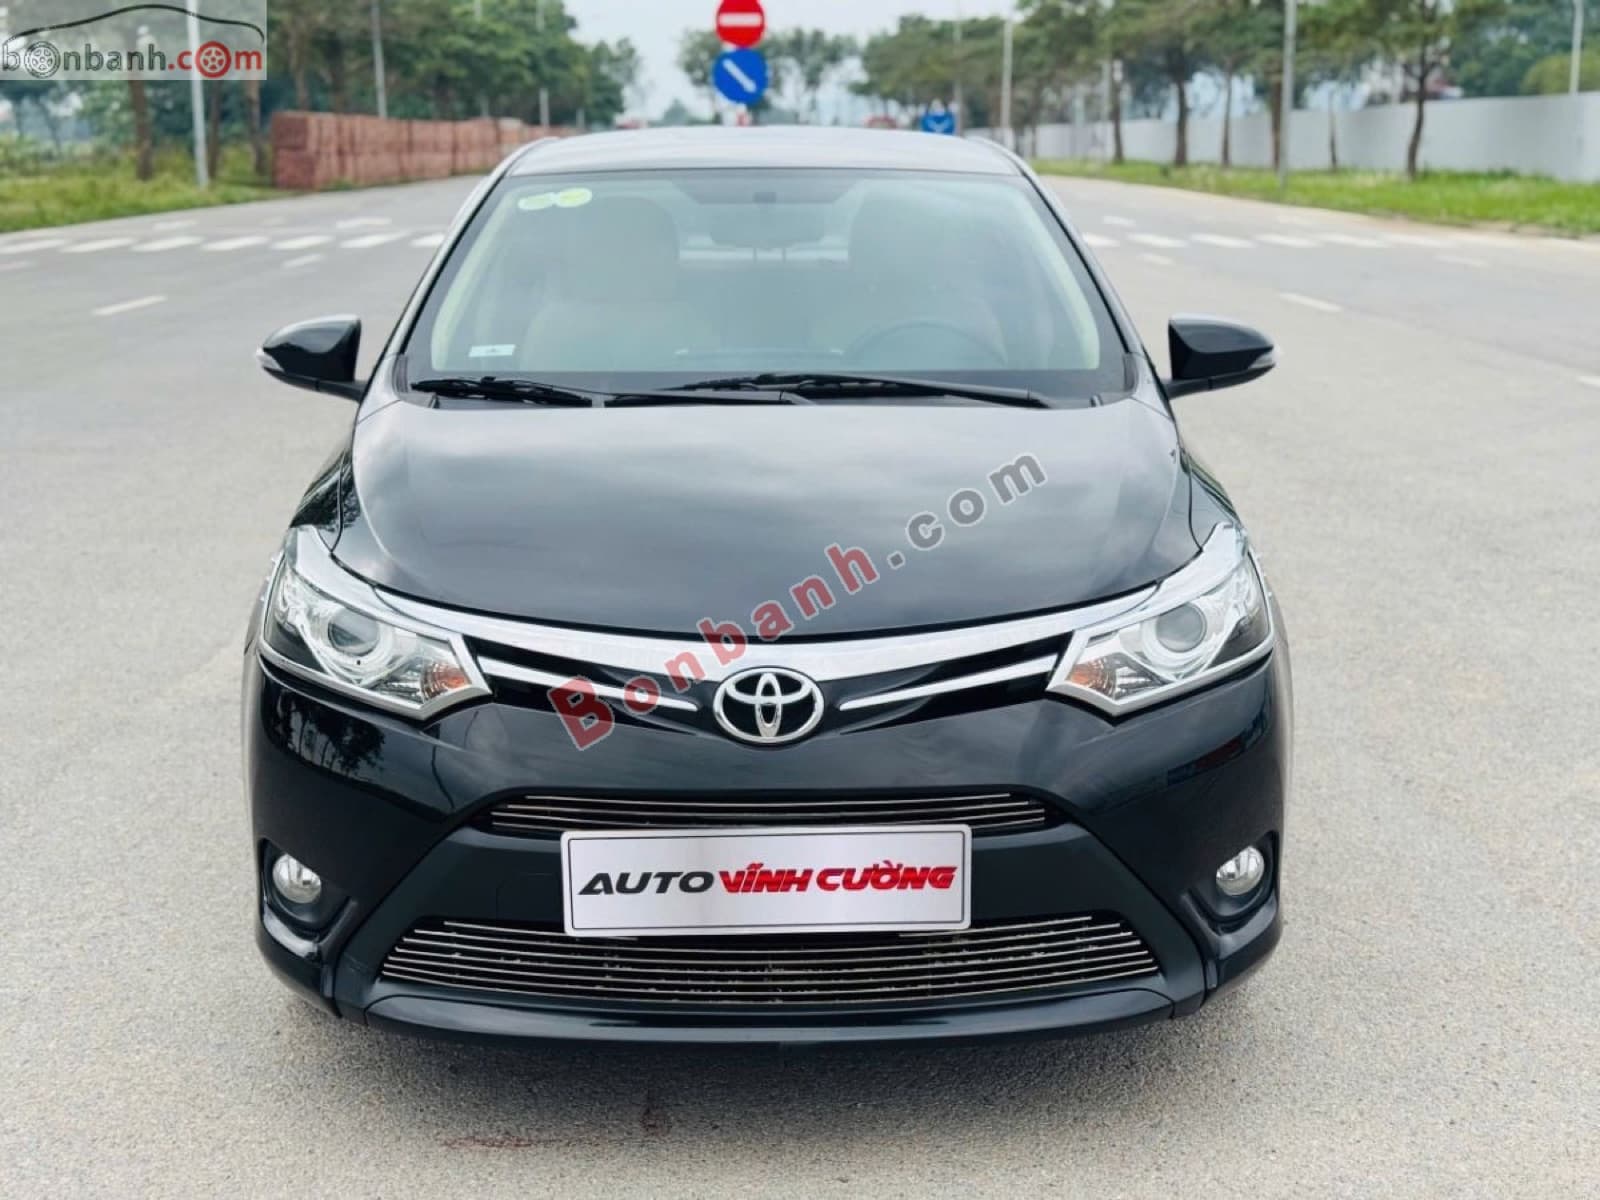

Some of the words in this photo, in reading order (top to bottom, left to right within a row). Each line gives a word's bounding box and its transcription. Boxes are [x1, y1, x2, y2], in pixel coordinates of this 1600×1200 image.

[578, 871, 714, 896] AUTO
[719, 862, 813, 893] VĨNH
[816, 860, 958, 891] CƯỜNG
